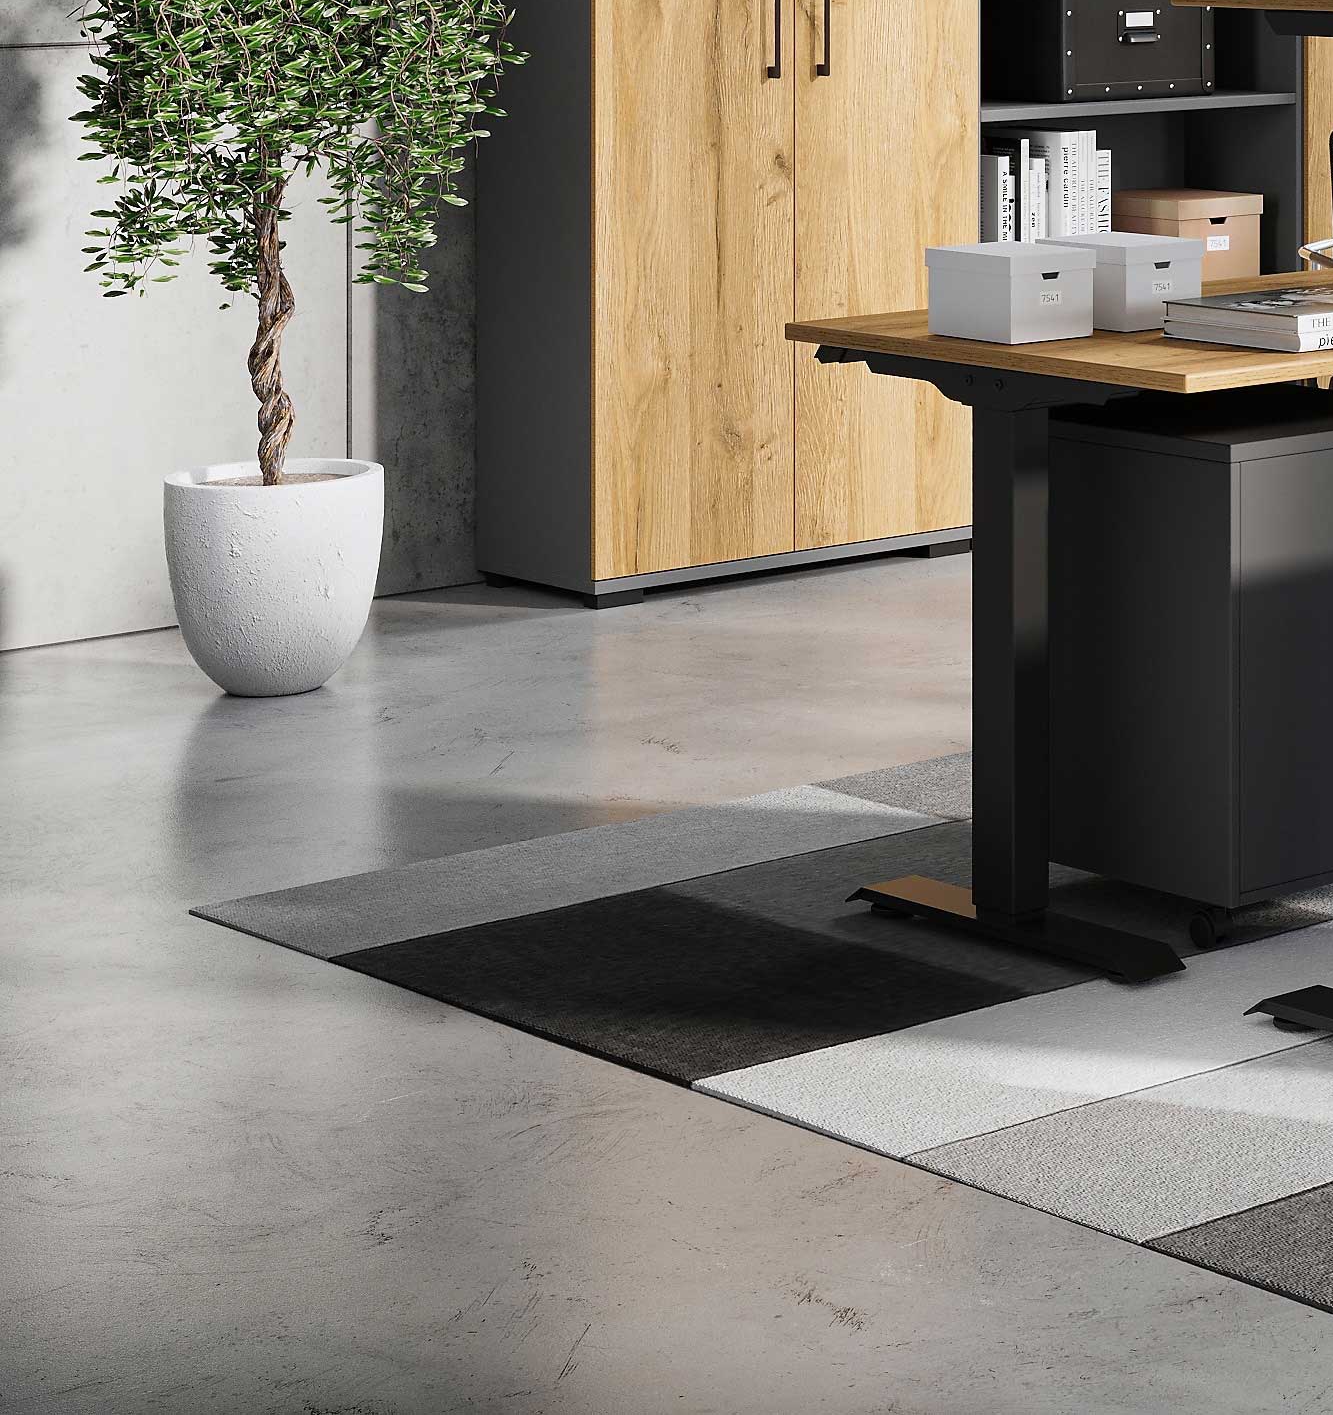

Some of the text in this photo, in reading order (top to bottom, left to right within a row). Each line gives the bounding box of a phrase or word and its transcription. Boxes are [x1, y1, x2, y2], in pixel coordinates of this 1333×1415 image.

[1062, 147, 1070, 175] pierre
[1098, 152, 1109, 183] THE
[1003, 205, 1008, 213] IN
[1153, 283, 1170, 291] 7541
[1041, 293, 1059, 303] 7541
[1312, 317, 1330, 328] THE
